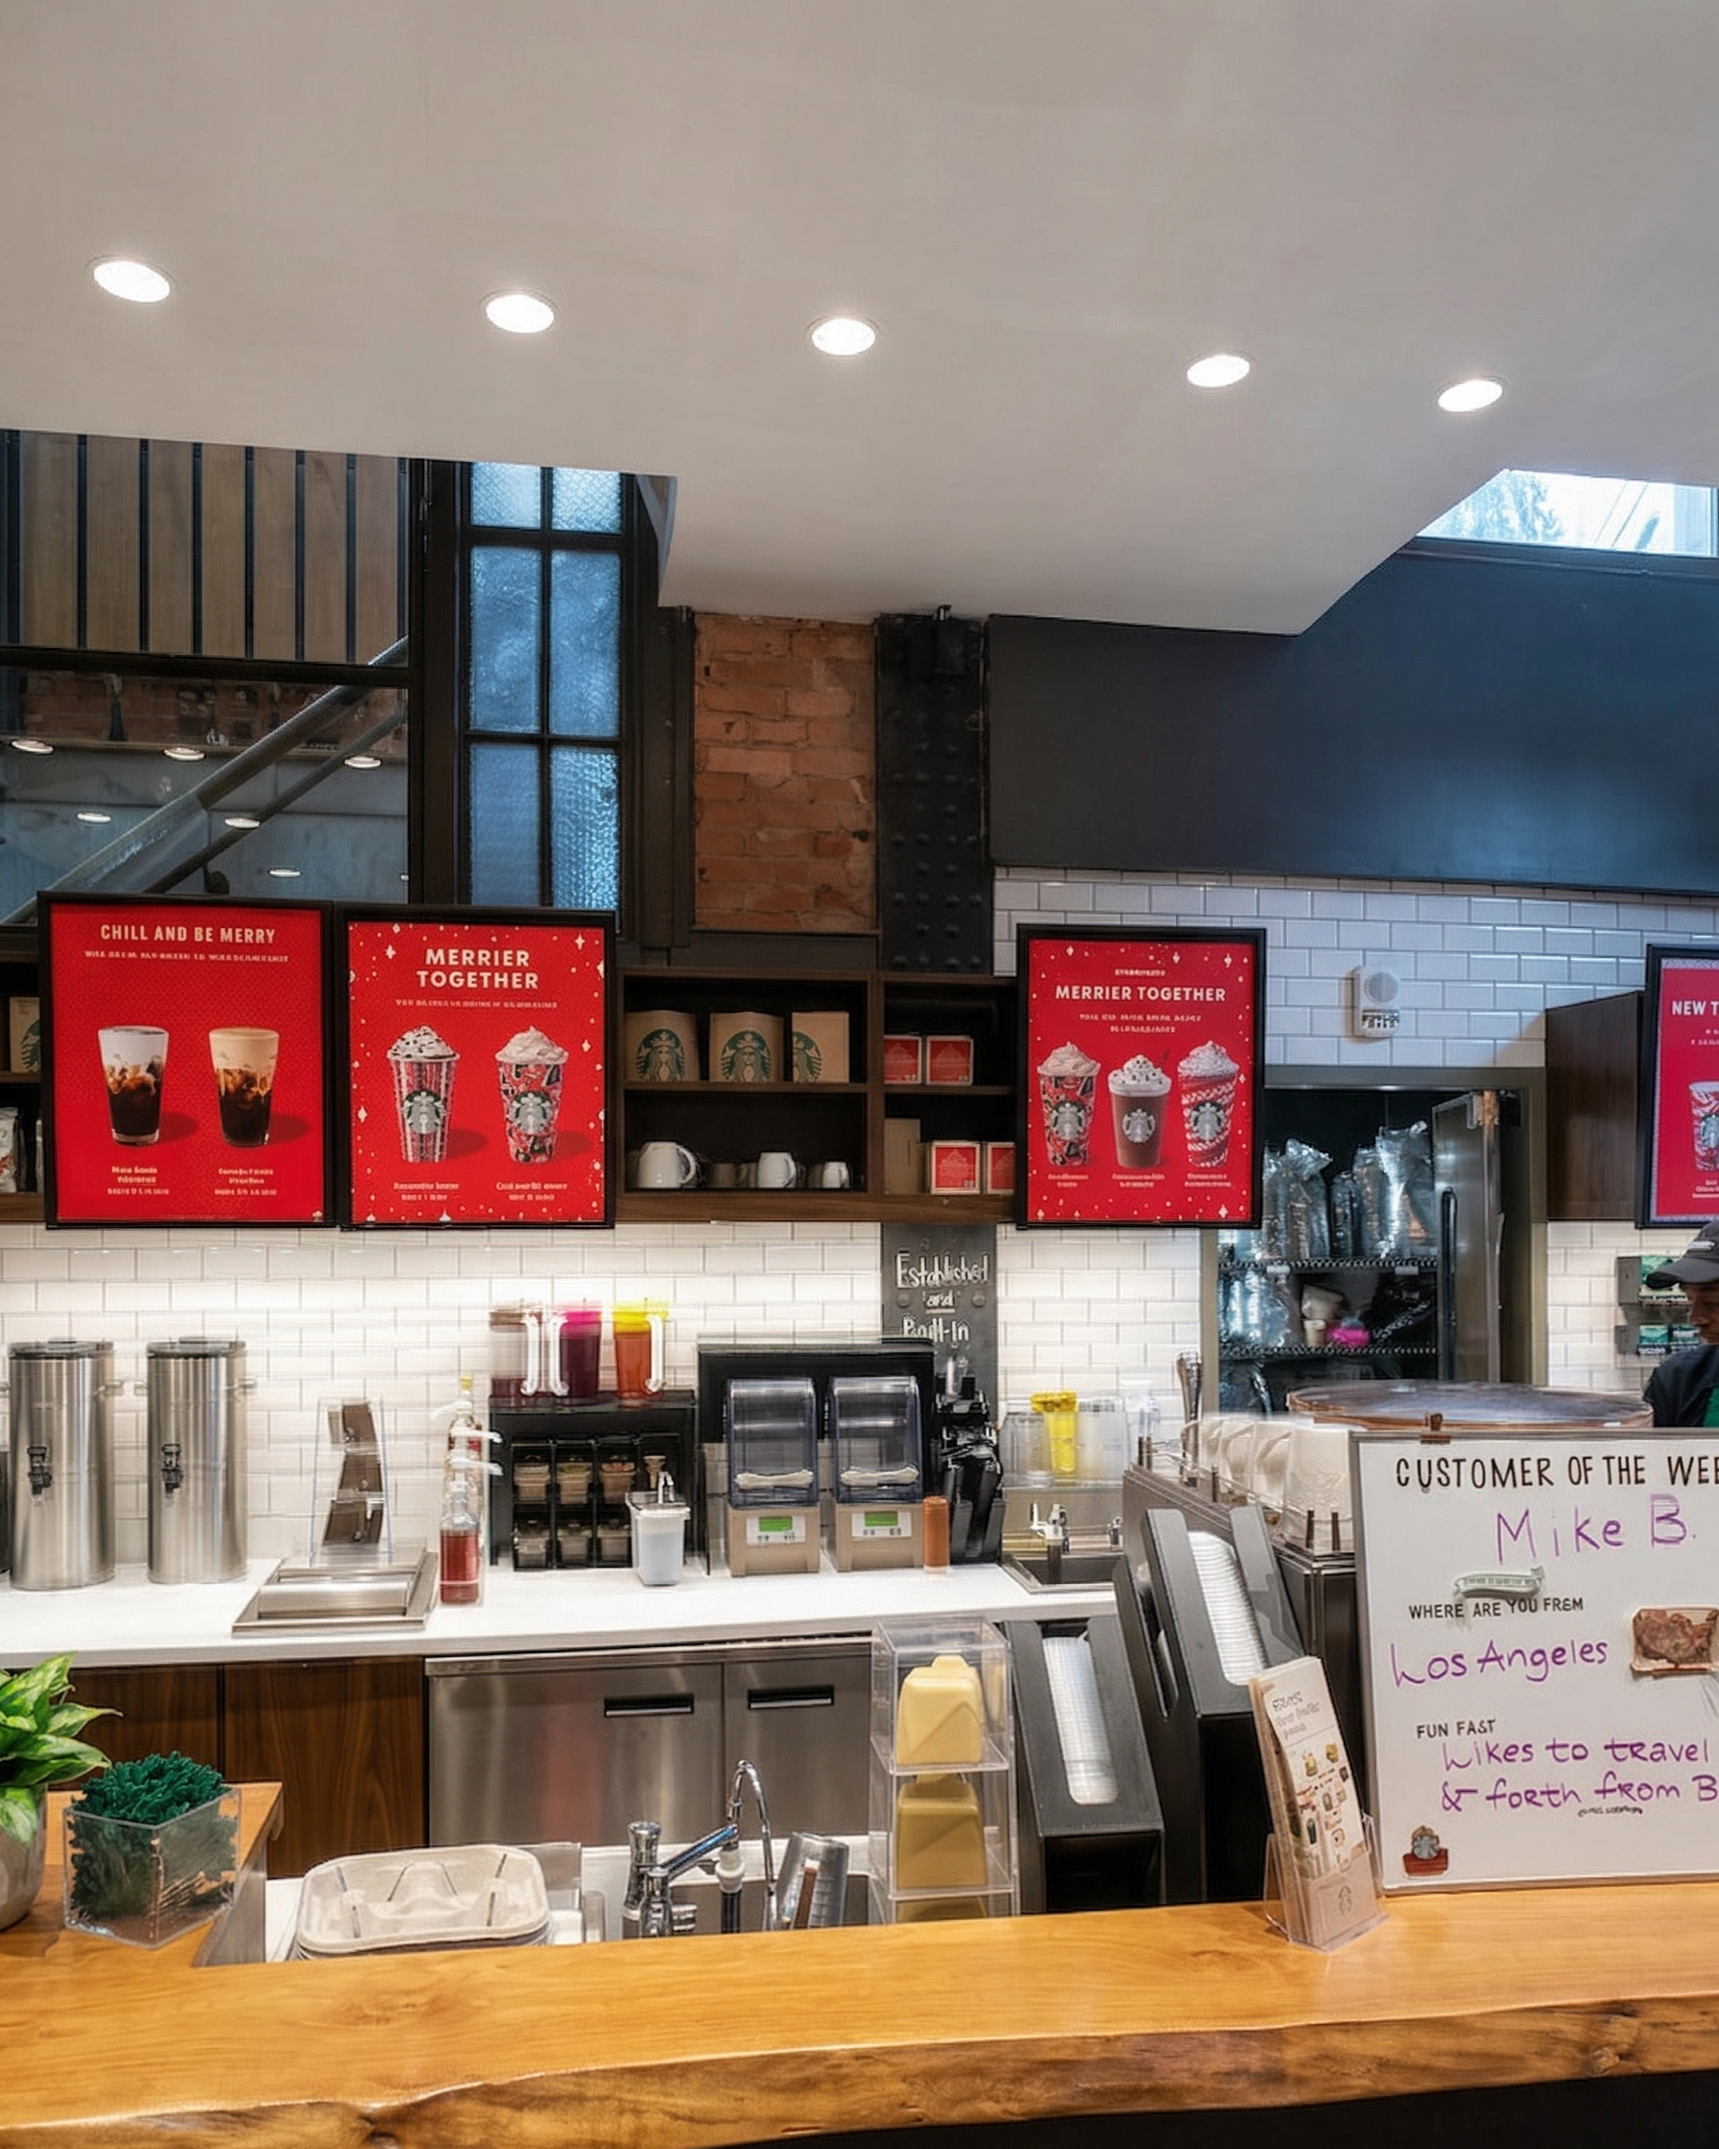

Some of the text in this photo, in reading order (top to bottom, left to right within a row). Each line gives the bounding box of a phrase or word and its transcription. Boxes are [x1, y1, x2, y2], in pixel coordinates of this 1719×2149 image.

[100, 924, 276, 944] CHILL AND BE MERRY
[425, 948, 530, 967] MERRIER
[416, 970, 539, 989] TOGETHER
[1055, 985, 1226, 1002] MERRIER TOGETHER
[1672, 1000, 1707, 1016] NEW
[1396, 1457, 1554, 1489] CUSTOMER
[1568, 1455, 1594, 1485] OF
[1602, 1455, 1646, 1485] THE
[1496, 1505, 1624, 1565] Mike
[1408, 1603, 1465, 1620] WHERE
[1473, 1601, 1502, 1617] ARE
[1508, 1597, 1538, 1614] YOU
[1390, 1638, 1608, 1688] Los Angeles
[1416, 1723, 1449, 1740] FUN
[1442, 1740, 1535, 1772] Likes
[1545, 1737, 1589, 1763] to
